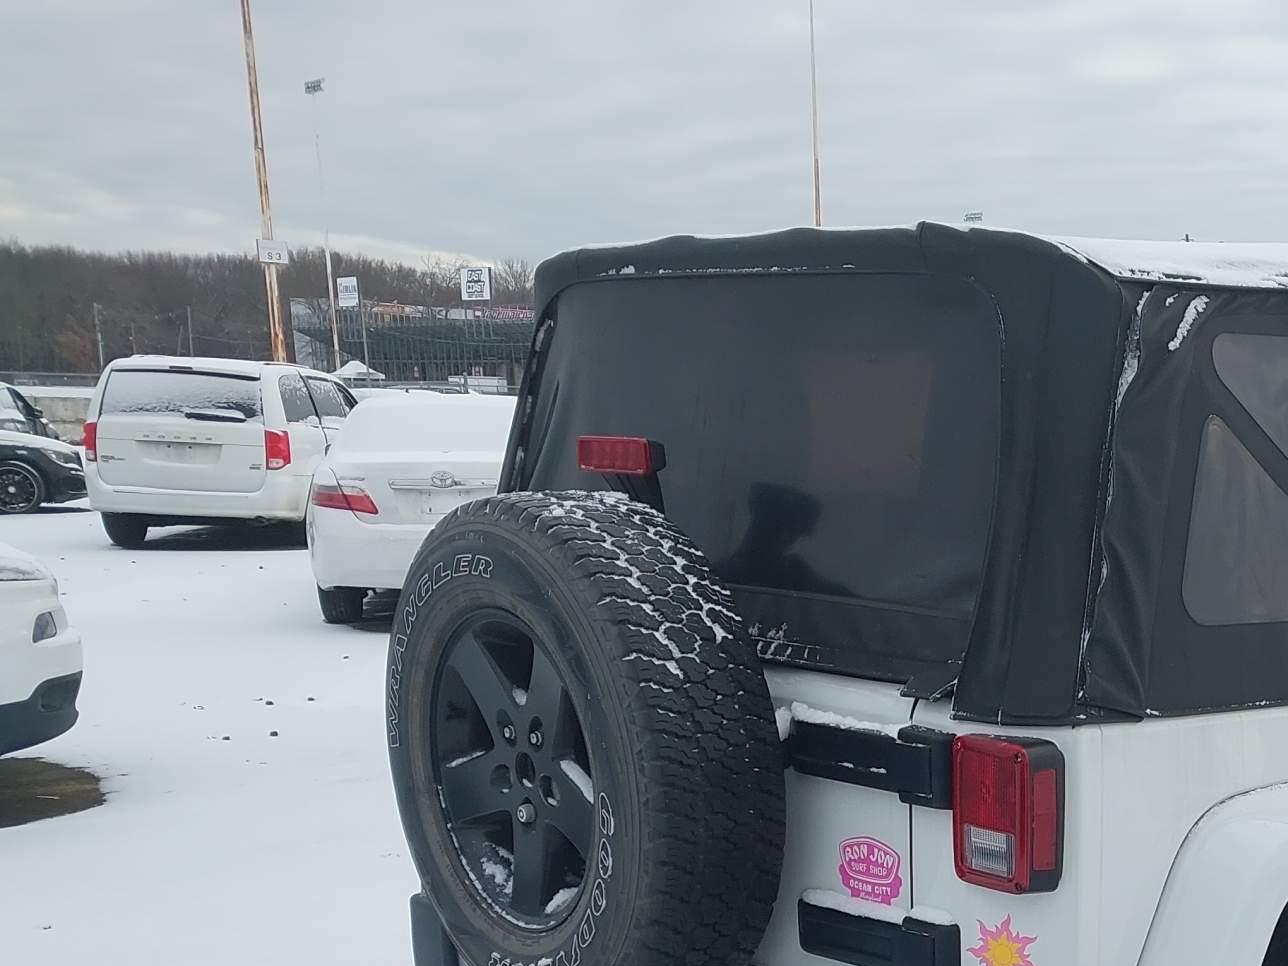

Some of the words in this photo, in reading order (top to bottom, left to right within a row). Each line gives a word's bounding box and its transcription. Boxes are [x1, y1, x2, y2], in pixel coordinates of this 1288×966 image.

[389, 554, 494, 748] WRANGLER
[845, 844, 868, 862] RON
[870, 847, 894, 869] JON
[851, 862, 867, 872] SURF
[870, 865, 888, 876] SHOP
[850, 879, 872, 892] OCEAN
[874, 886, 891, 897] CITY
